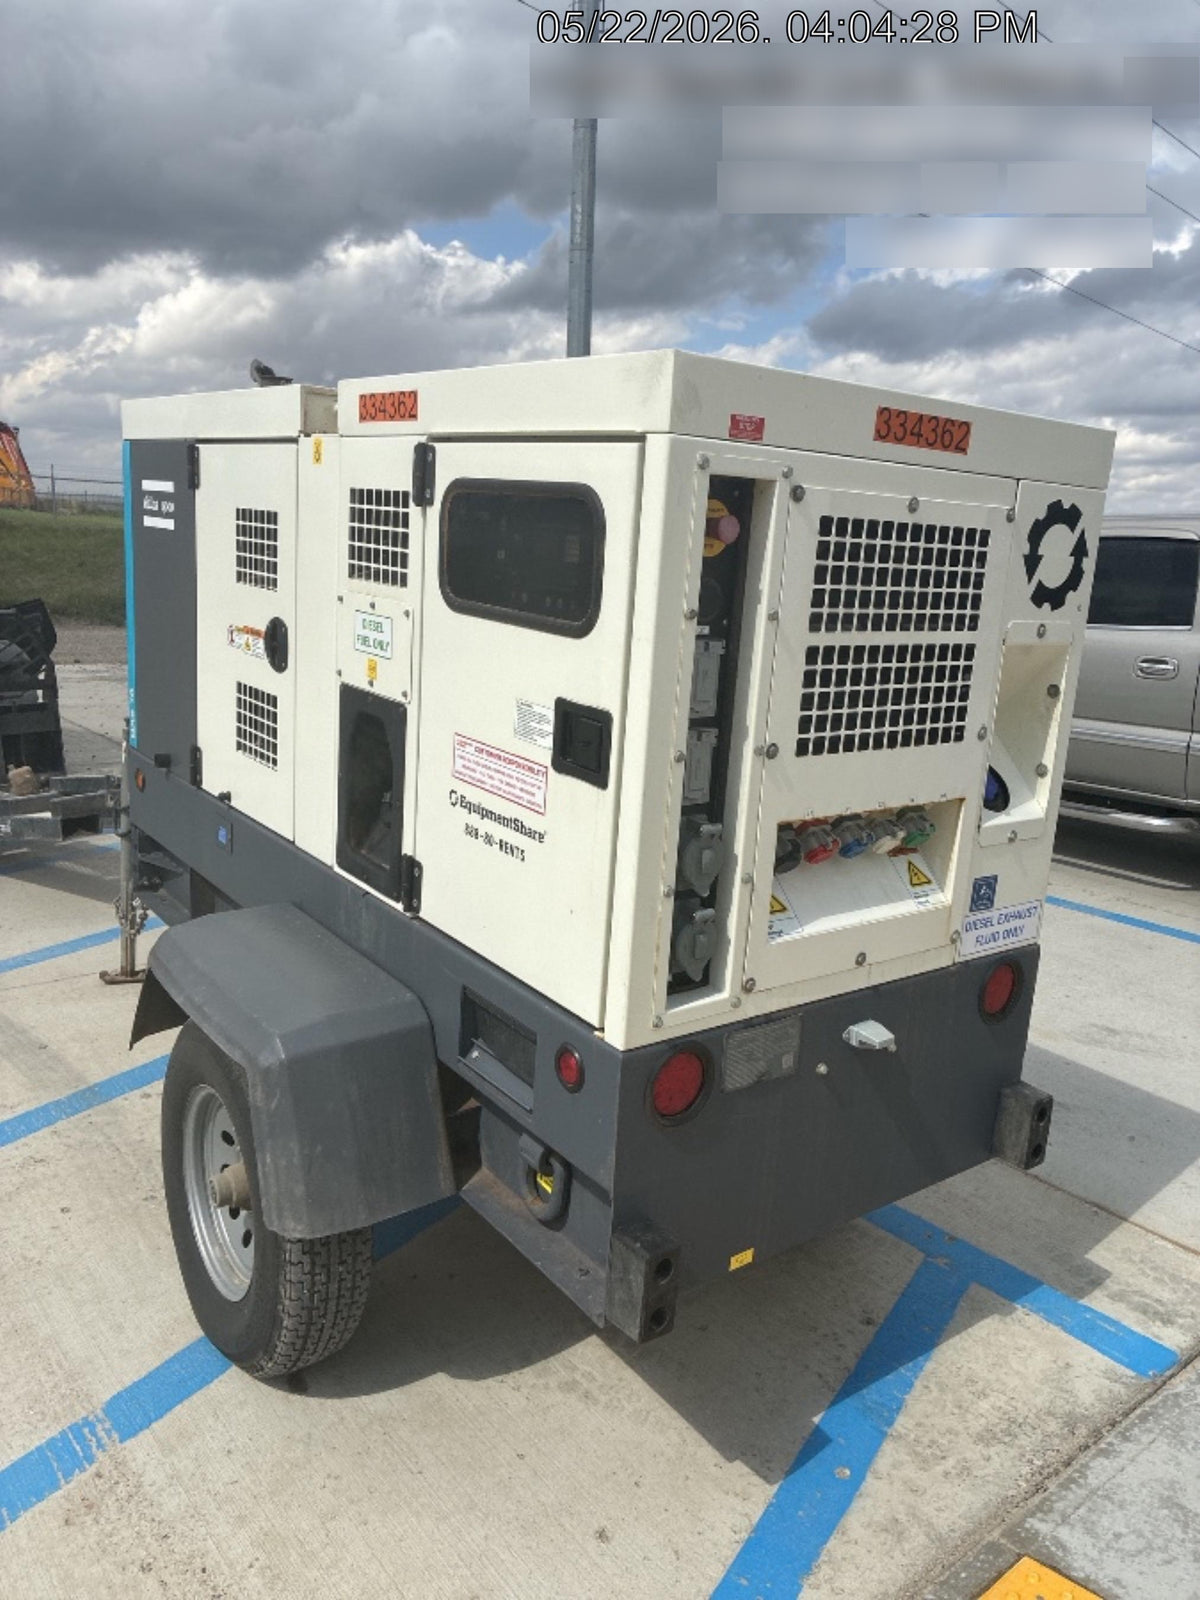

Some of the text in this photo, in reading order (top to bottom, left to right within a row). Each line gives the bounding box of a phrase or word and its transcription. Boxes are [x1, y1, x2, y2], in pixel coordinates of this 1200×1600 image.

[360, 391, 417, 420] 334362
[877, 406, 970, 452] 334362
[460, 794, 545, 843] EquipmentShare
[965, 905, 1038, 933] DIESEL EXHAUST
[975, 924, 1025, 948] FLUID ONLY
